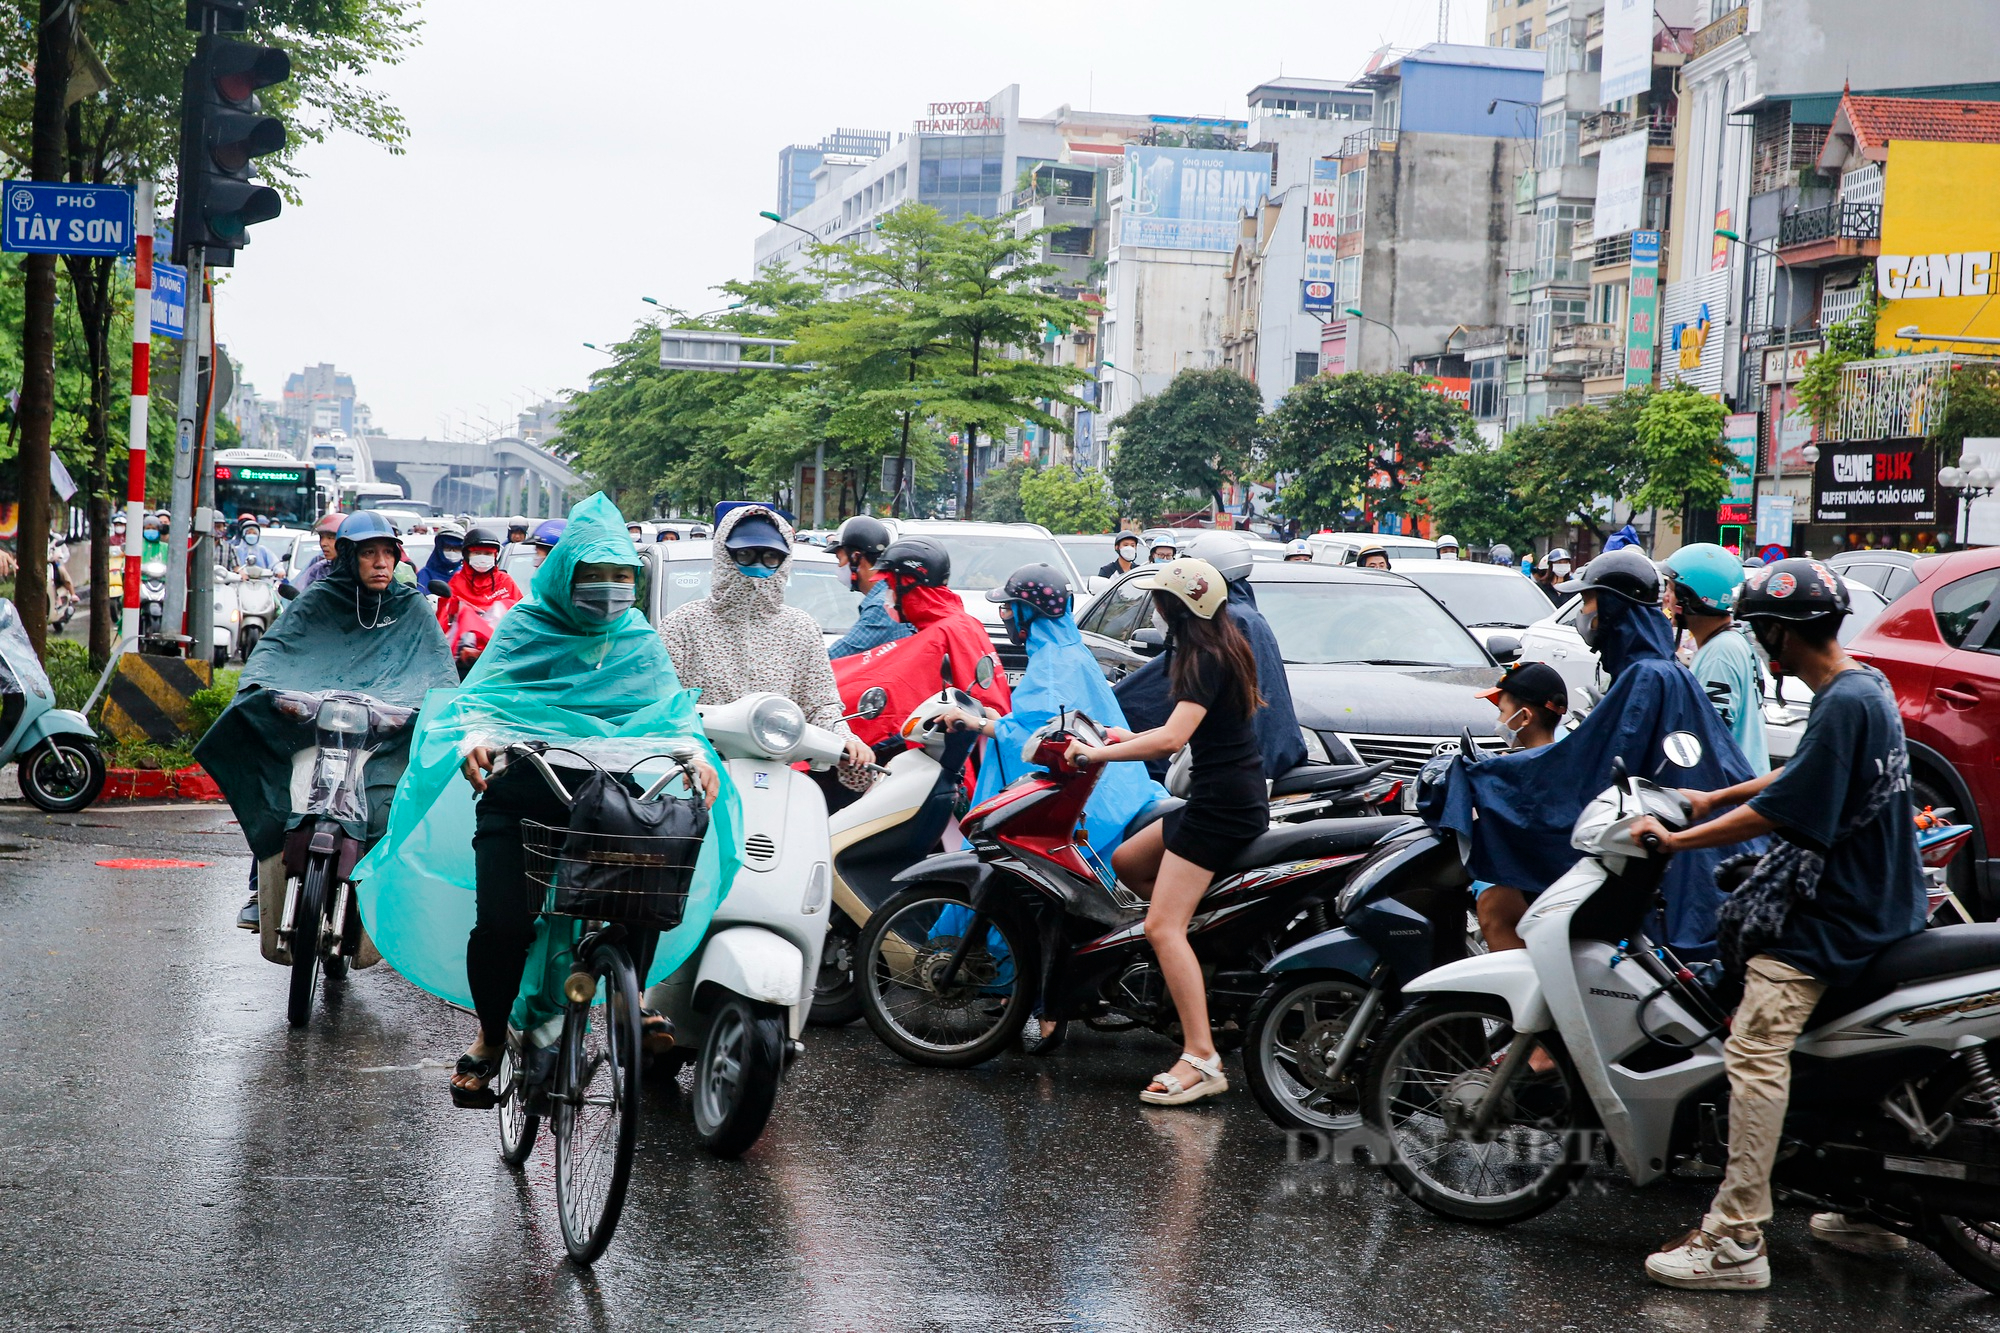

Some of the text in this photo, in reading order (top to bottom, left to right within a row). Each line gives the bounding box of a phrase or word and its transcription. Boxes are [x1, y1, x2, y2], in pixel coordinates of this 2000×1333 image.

[929, 101, 985, 115] TOYOTA
[915, 119, 959, 131] THANH
[1181, 168, 1261, 197] DISMY
[56, 192, 97, 209] PHỐ
[1313, 188, 1335, 207] MÁY
[15, 213, 123, 244] TÂY SƠN
[1313, 212, 1335, 228] BƠM
[1308, 230, 1337, 250] NƯỚC
[1636, 233, 1658, 244] 375
[1877, 250, 1992, 299] GANG
[1633, 272, 1654, 298] BÁNH
[1833, 454, 1873, 483] GANG
[1821, 491, 1847, 505] BUFFET
[1848, 485, 1875, 504] NƯỚNG
[1877, 484, 1900, 504] CHẢO
[1901, 488, 1926, 503] GANG
[1589, 987, 1640, 1001] HONDA
